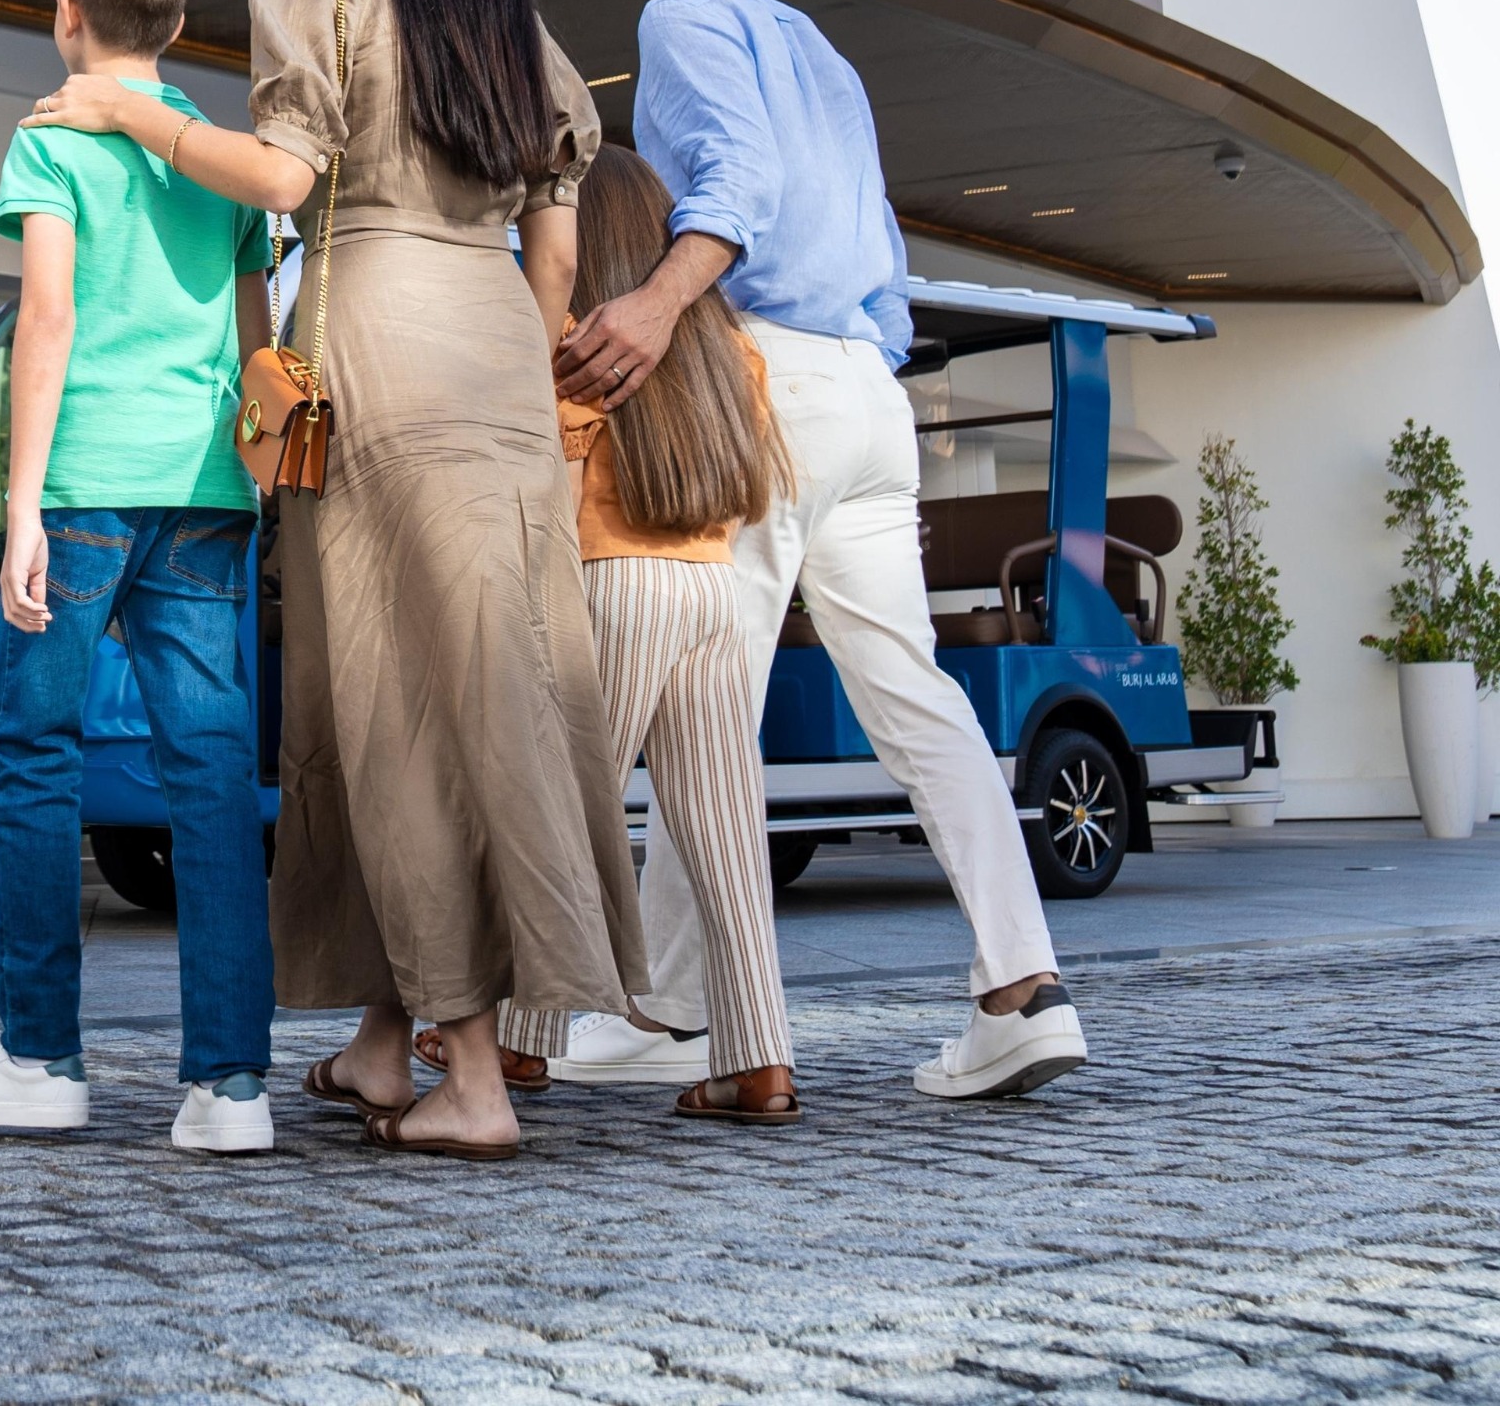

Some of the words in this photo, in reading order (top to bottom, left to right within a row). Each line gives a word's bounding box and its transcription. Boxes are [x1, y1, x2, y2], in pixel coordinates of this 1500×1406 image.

[1122, 673, 1142, 688] BURJ
[1143, 673, 1154, 686] AL
[1156, 672, 1178, 685] ARAB
